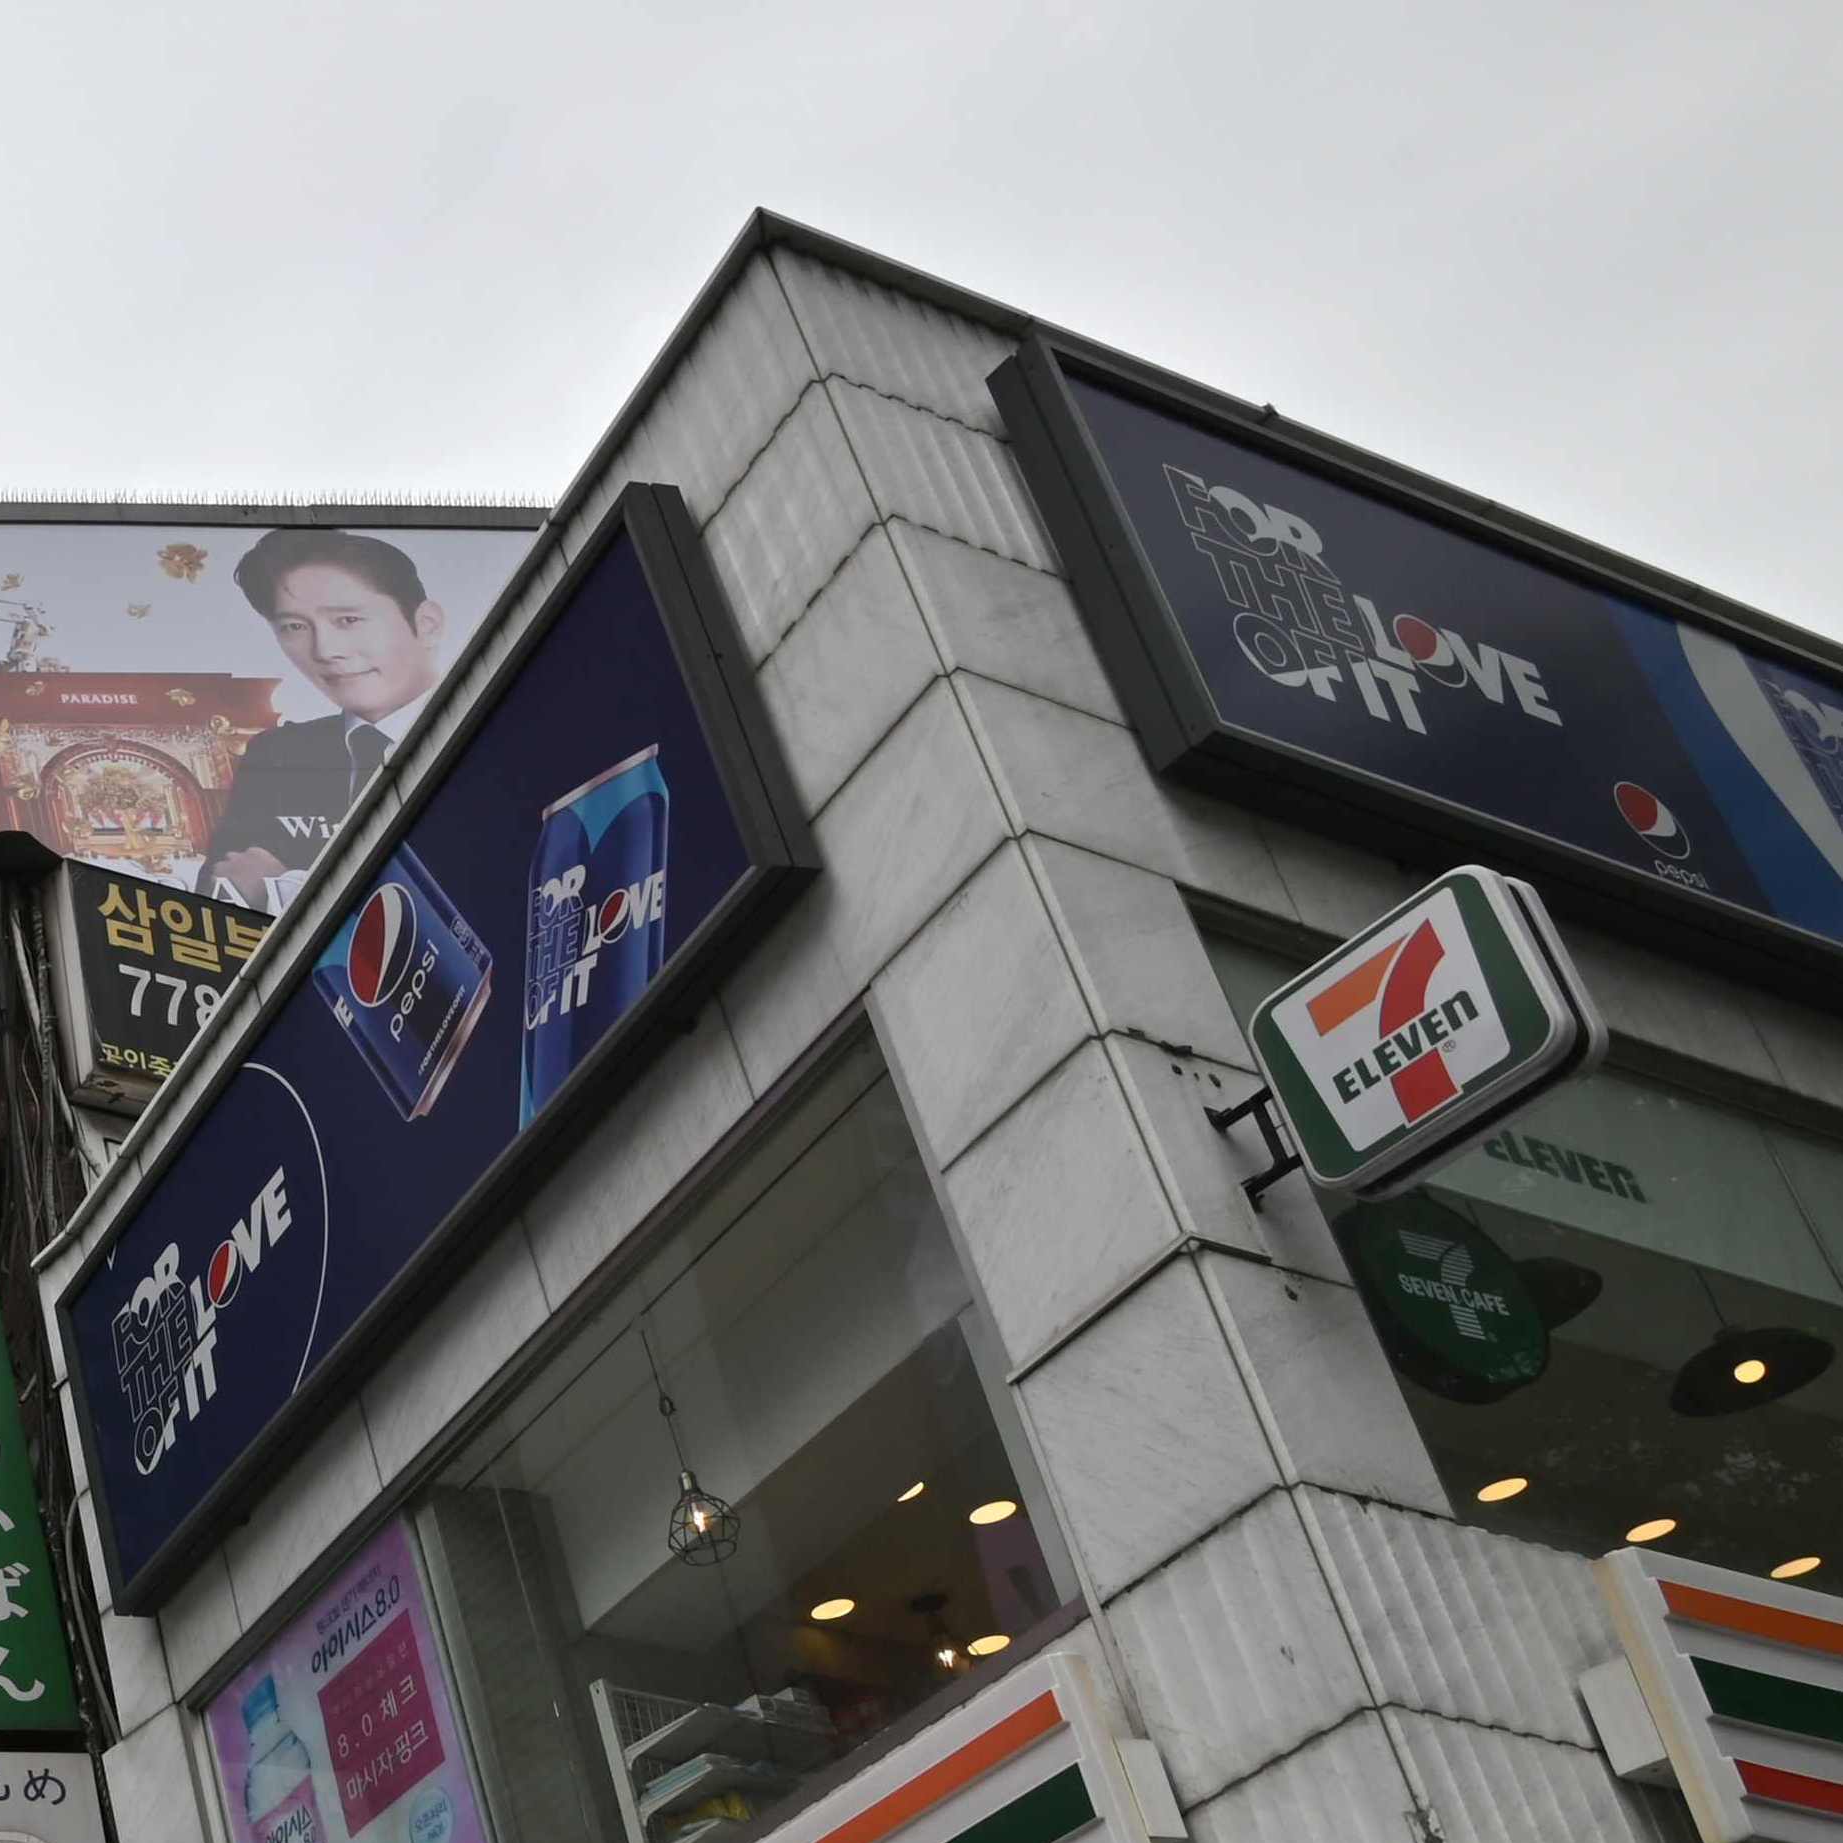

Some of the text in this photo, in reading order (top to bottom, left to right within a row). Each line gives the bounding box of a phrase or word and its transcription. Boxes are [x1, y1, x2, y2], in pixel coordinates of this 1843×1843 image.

[1162, 463, 1342, 588] FOR
[61, 694, 138, 705] PARADISE
[1353, 594, 1563, 728] LOVE
[533, 864, 586, 933] FOR
[576, 868, 666, 960] LOVE
[389, 938, 441, 1044] pepsi
[191, 1165, 294, 1336] LOVE
[1396, 1270, 1459, 1308] SEVEN
[114, 1242, 189, 1378] FOR
